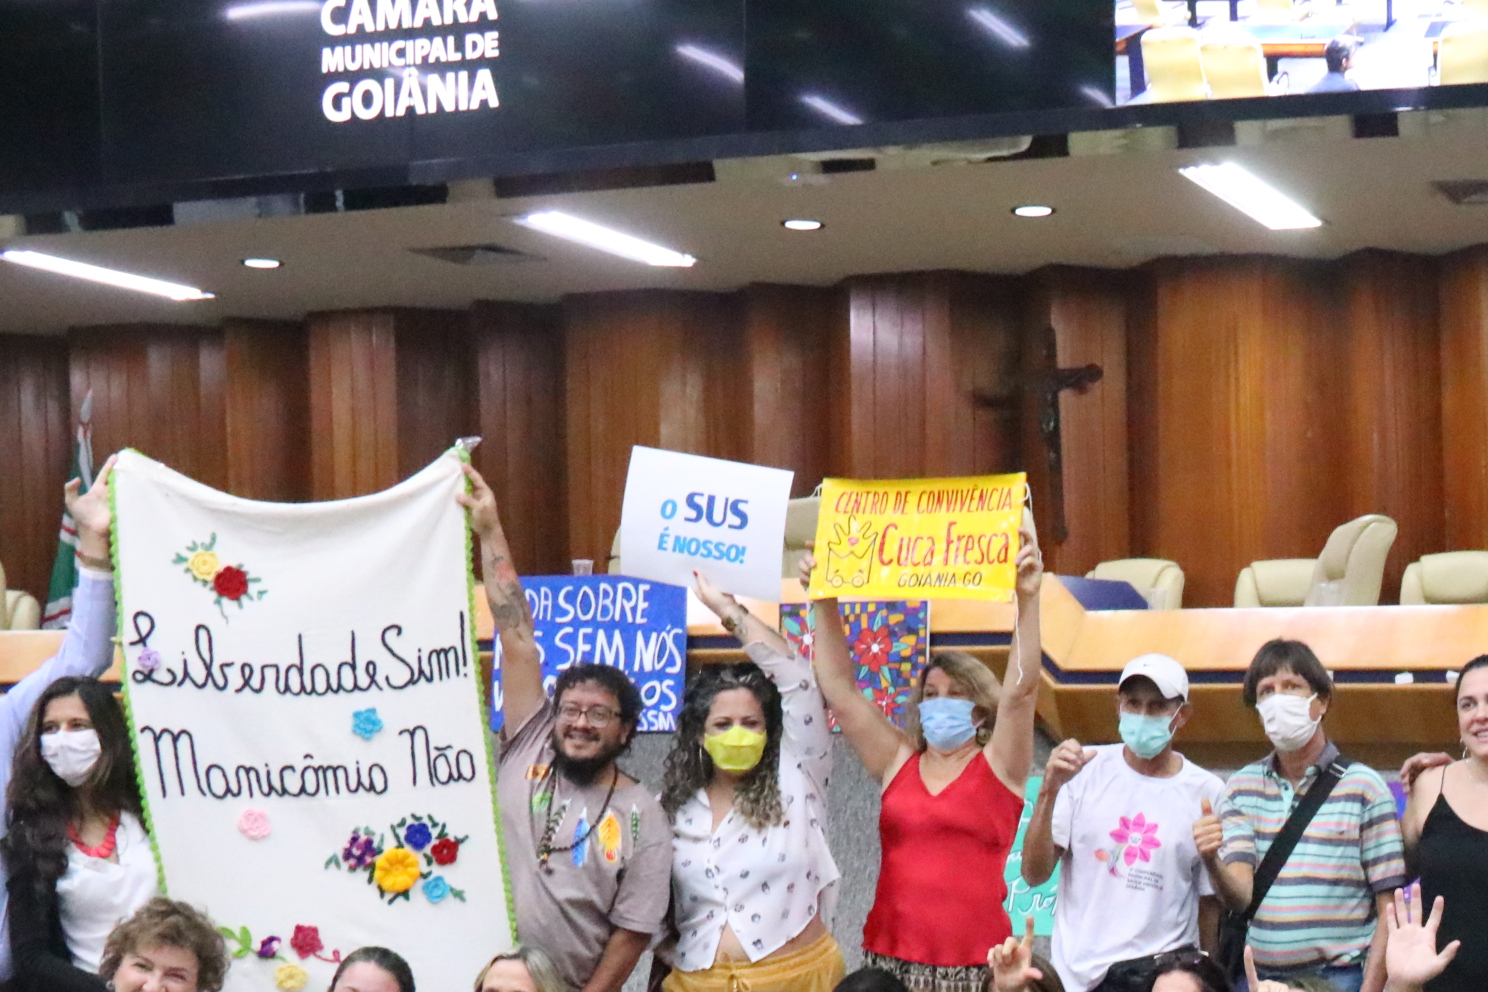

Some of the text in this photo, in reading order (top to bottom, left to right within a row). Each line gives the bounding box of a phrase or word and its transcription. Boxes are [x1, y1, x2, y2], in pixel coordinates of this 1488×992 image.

[321, 31, 500, 74] MUNICIPAL DE
[321, 66, 500, 123] GOIÂNIA
[684, 491, 749, 531] SUS
[835, 484, 1013, 515] CENTRO DE CONVIVÊNCIA
[657, 526, 747, 565] É NOSSO!
[878, 521, 1010, 567] Cuca Fresca
[555, 582, 650, 624] SOBRE
[129, 611, 383, 696] Liberdade
[381, 610, 468, 690] Sim!
[633, 624, 683, 675] NÓS
[140, 725, 476, 800] Manicômio Não
